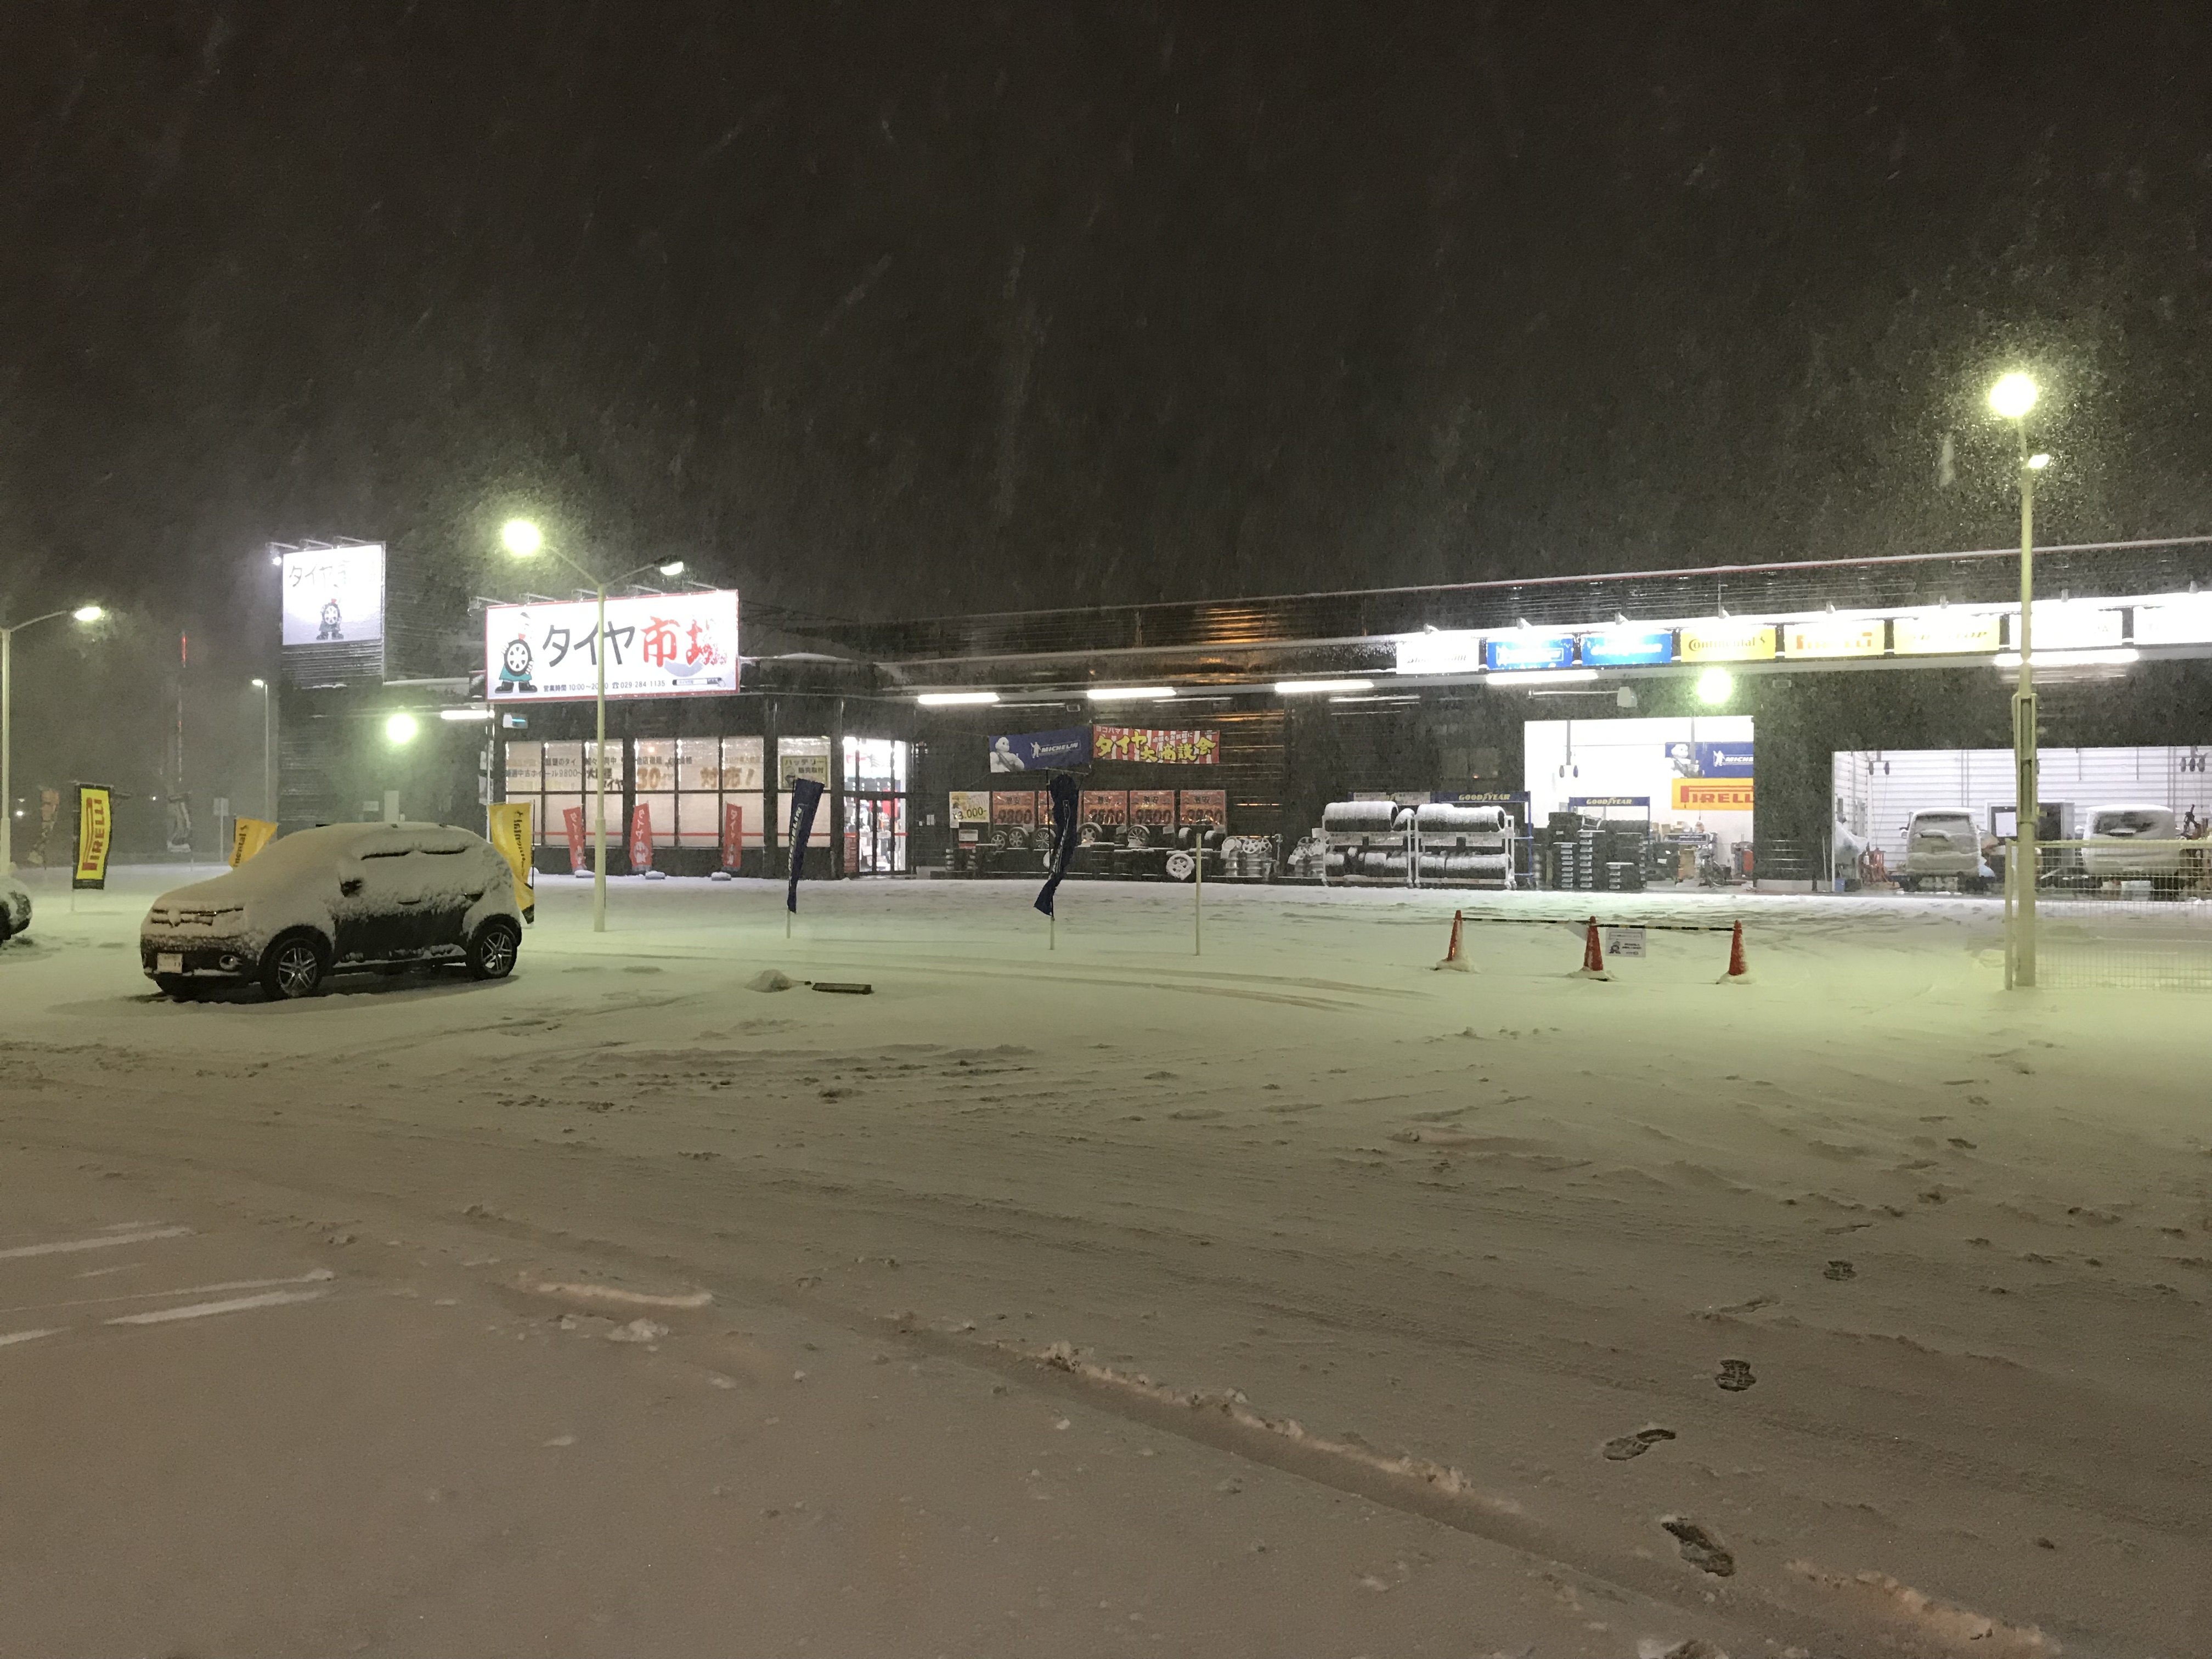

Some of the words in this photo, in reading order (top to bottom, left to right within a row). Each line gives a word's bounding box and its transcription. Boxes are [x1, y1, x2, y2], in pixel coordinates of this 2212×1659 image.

[1796, 631, 1872, 650] PIRLLI
[1041, 742, 1079, 753] MICHELIN
[1458, 792, 1511, 802] GOODYEAR
[1586, 797, 1632, 805] GOODYEAR
[82, 797, 105, 871] PIRELLI
